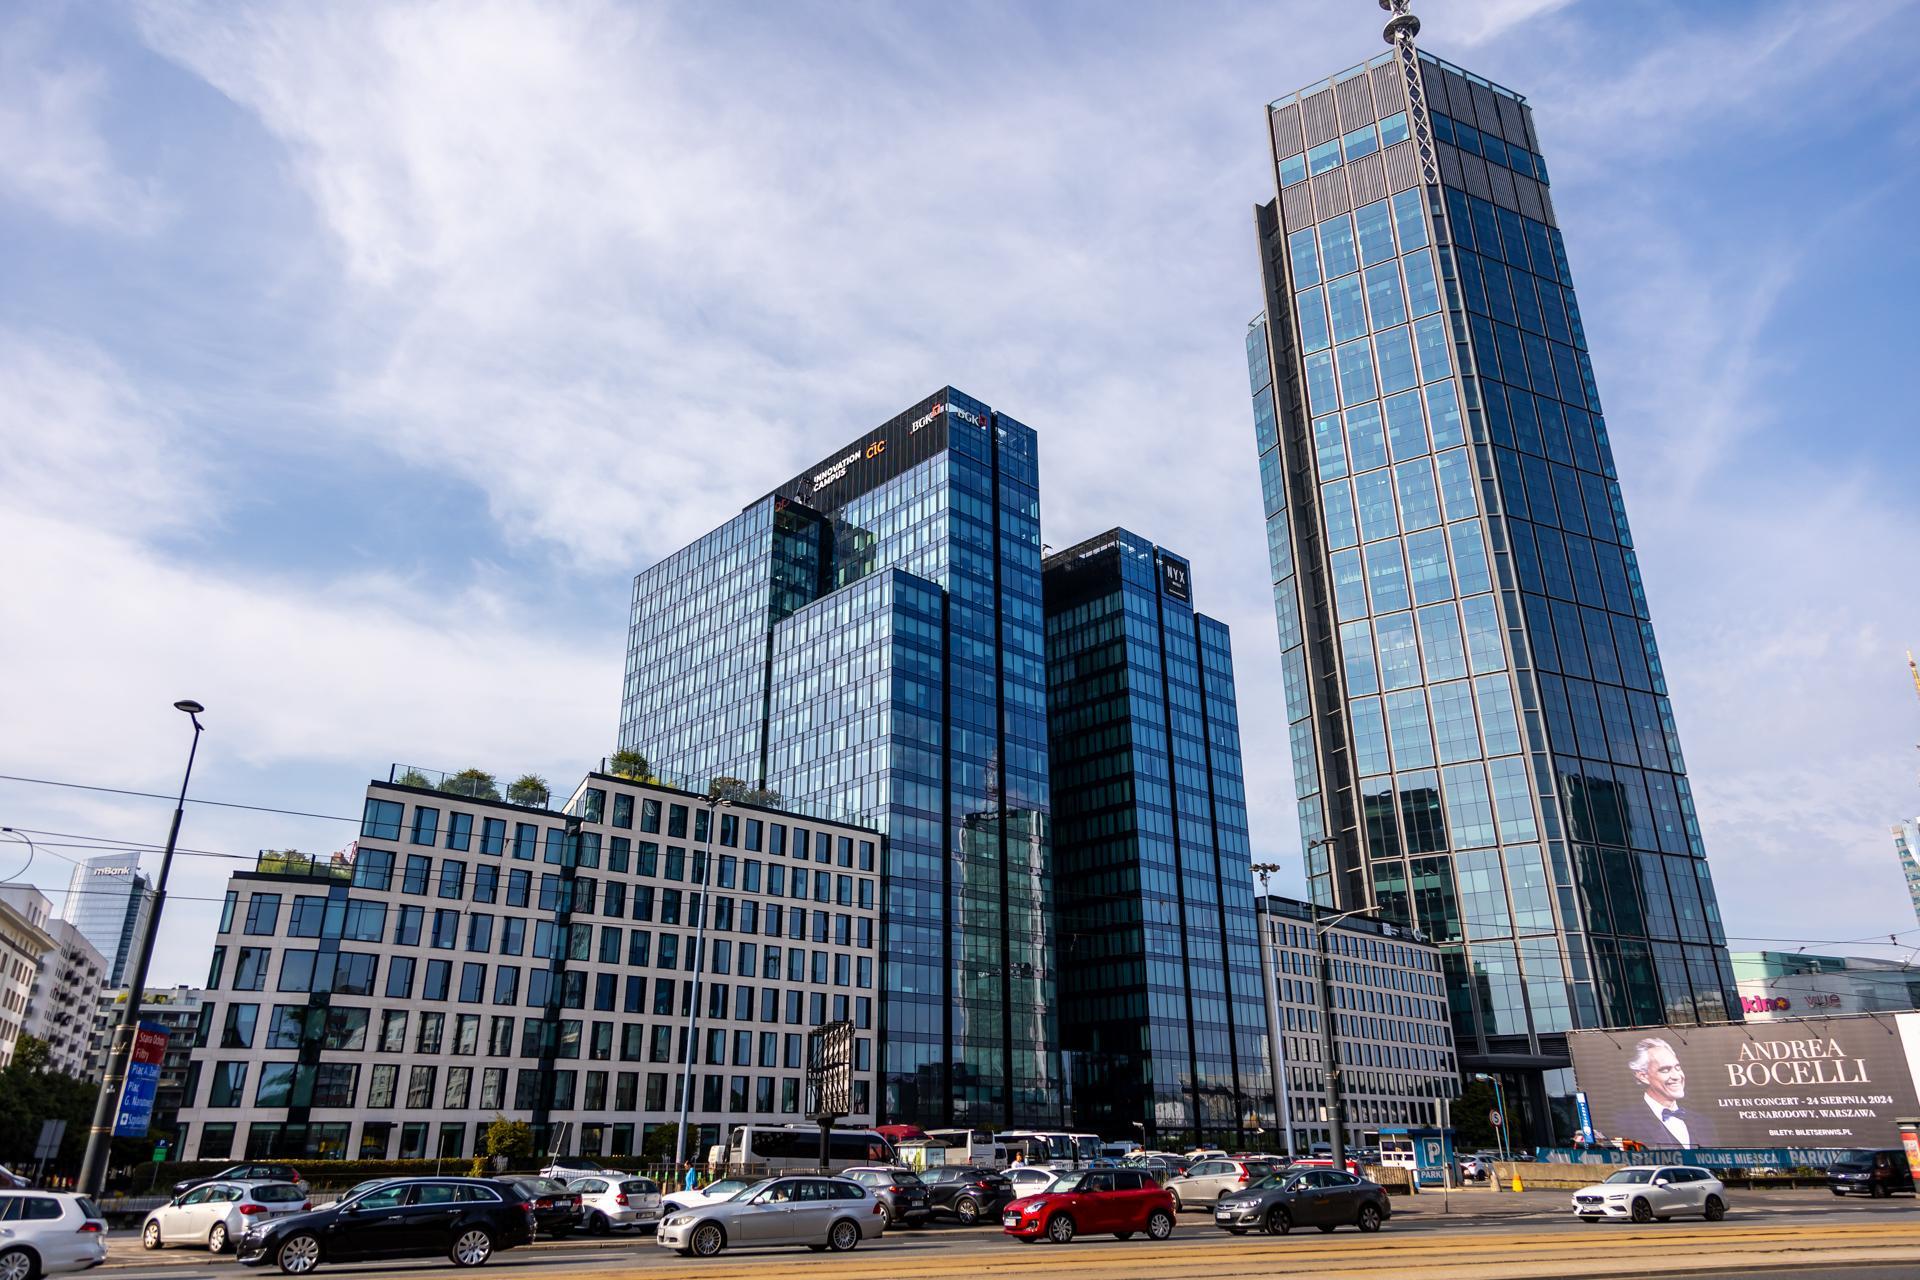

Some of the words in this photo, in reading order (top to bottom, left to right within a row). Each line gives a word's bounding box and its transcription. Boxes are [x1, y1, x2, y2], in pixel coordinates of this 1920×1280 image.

[912, 414, 933, 432] BGK
[957, 409, 979, 426] BGK
[813, 450, 861, 482] INNOVATION
[813, 468, 846, 492] CAMPUS
[1167, 565, 1185, 584] NYX
[95, 866, 129, 876] mBank
[1738, 1038, 1847, 1062] ANDREA
[1724, 1058, 1872, 1087] BOCELLI
[1718, 1098, 1741, 1107] LIVE
[1742, 1098, 1752, 1107] IN
[1752, 1097, 1799, 1106] CONCERT
[1806, 1096, 1819, 1105] 24
[1820, 1095, 1868, 1105] SIERPNIA
[1868, 1095, 1893, 1104] 2024
[1739, 1110, 1758, 1119] PGE
[1759, 1109, 1819, 1119] NARODOWY,
[1819, 1109, 1876, 1118] WARSZAWA
[1795, 1128, 1853, 1136] BILETSERWIS.PL
[1427, 1142, 1440, 1164] P
[1610, 1151, 1684, 1166] PARKING
[1695, 1152, 1732, 1164] WOLNE
